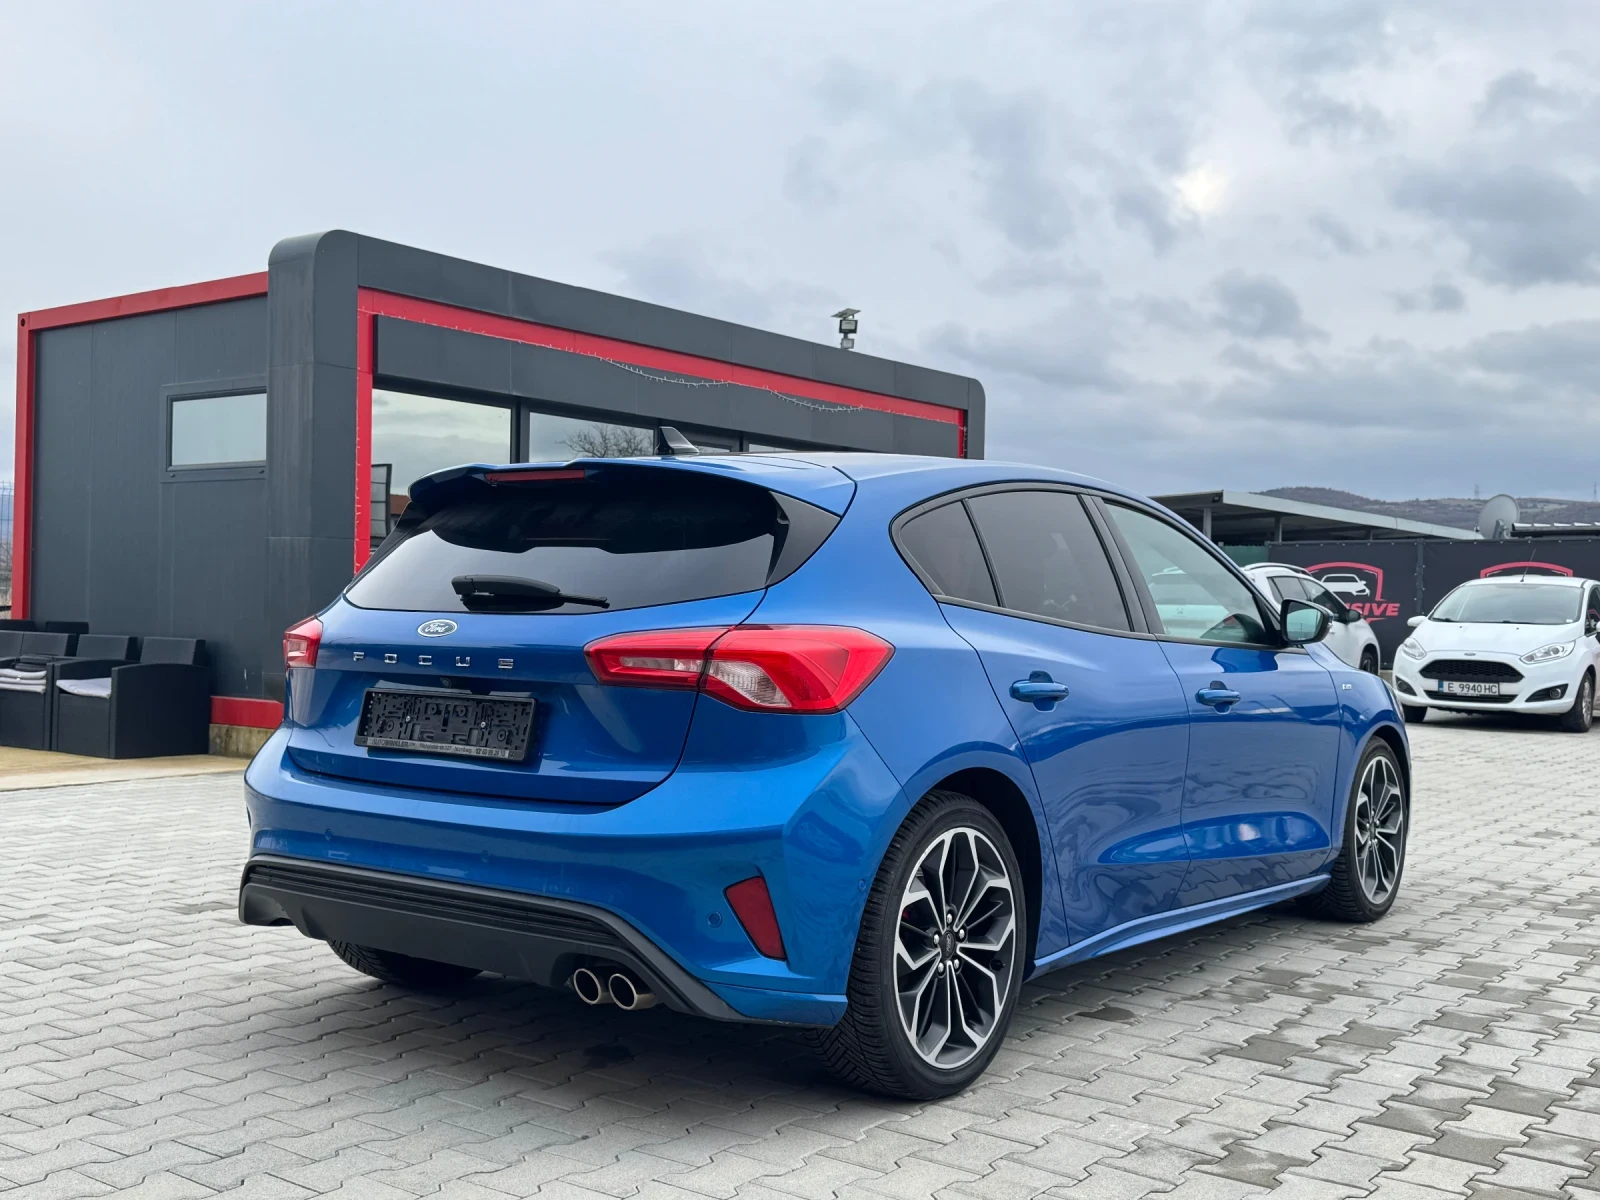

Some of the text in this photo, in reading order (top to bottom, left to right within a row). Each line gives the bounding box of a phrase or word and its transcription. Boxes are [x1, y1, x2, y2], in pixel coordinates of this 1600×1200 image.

[1345, 603, 1400, 616] SIVE
[424, 621, 449, 633] Ford
[353, 651, 514, 669] FOCUS
[1447, 682, 1497, 694] E 9940 HC
